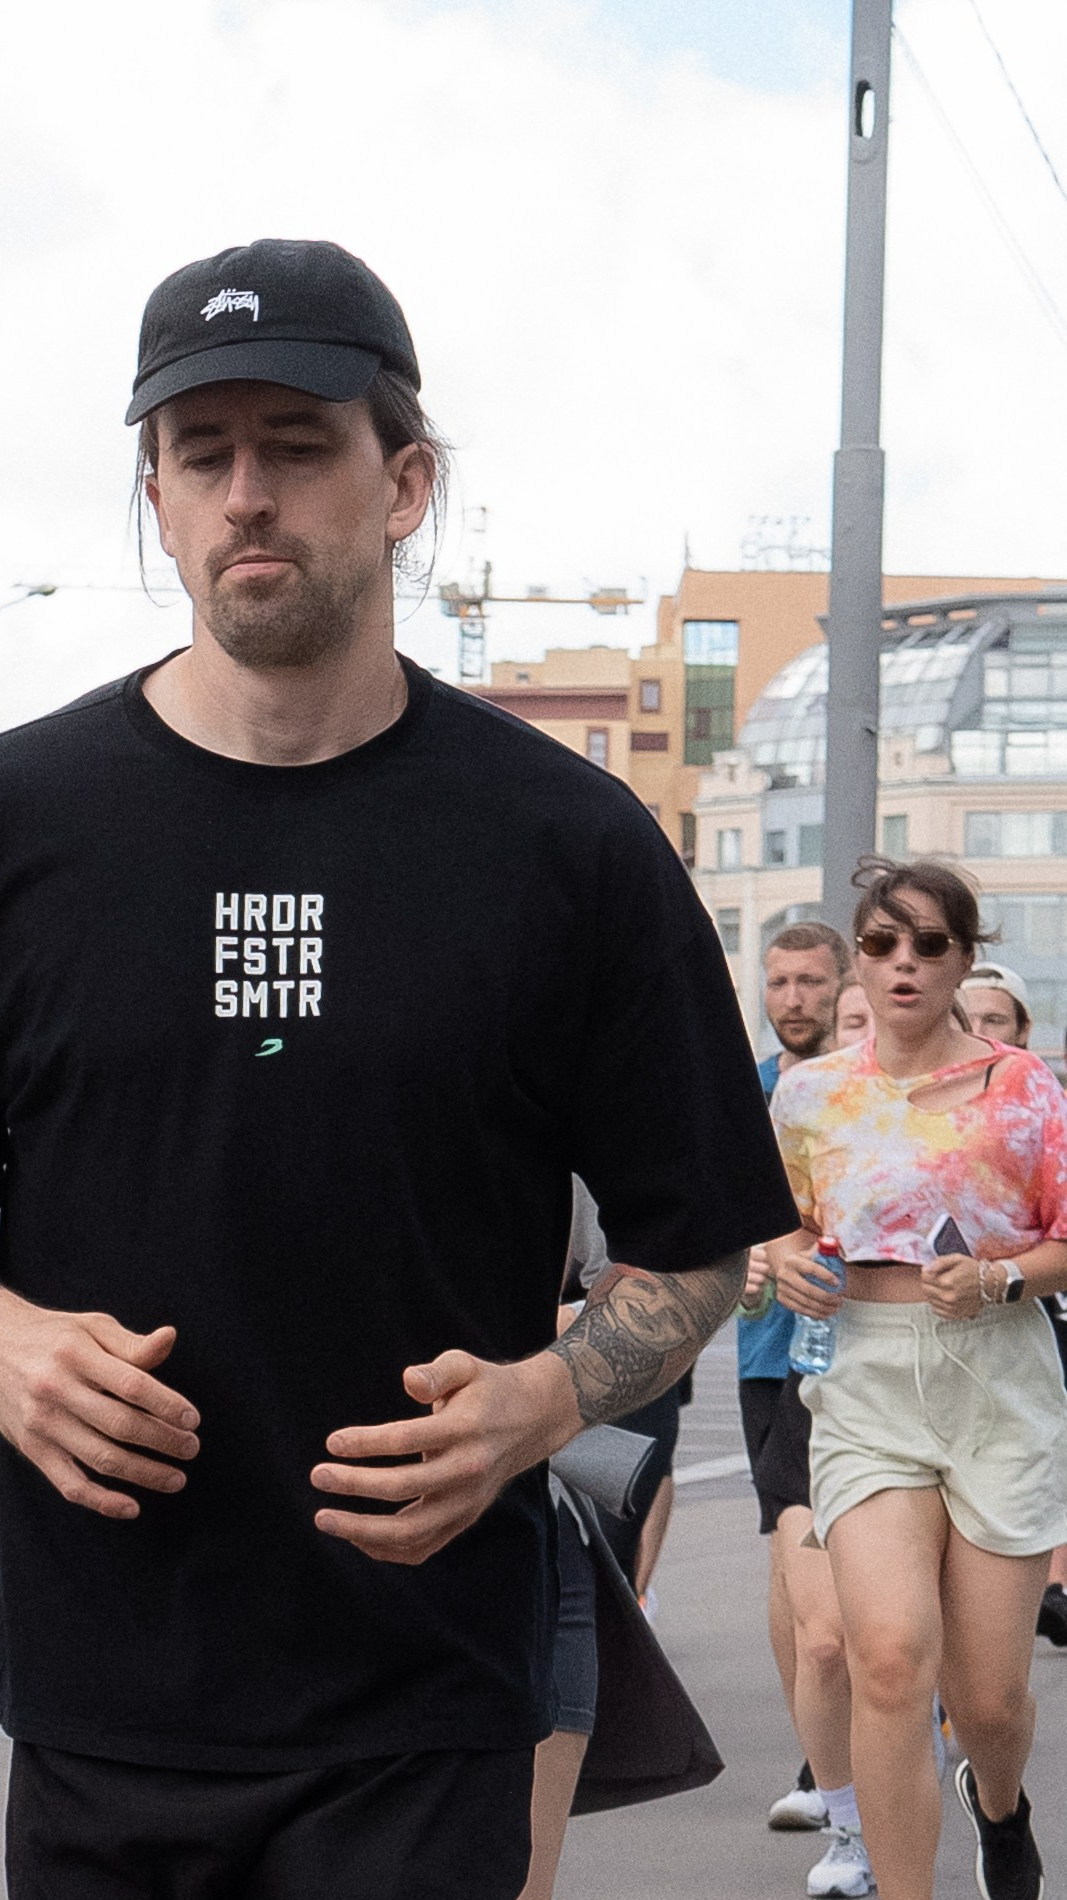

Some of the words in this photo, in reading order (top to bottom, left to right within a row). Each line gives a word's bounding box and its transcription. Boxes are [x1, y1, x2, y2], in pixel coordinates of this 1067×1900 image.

[214, 892, 324, 932] HRDR
[214, 936, 323, 975] FSTR
[214, 979, 323, 1019] SMTR
